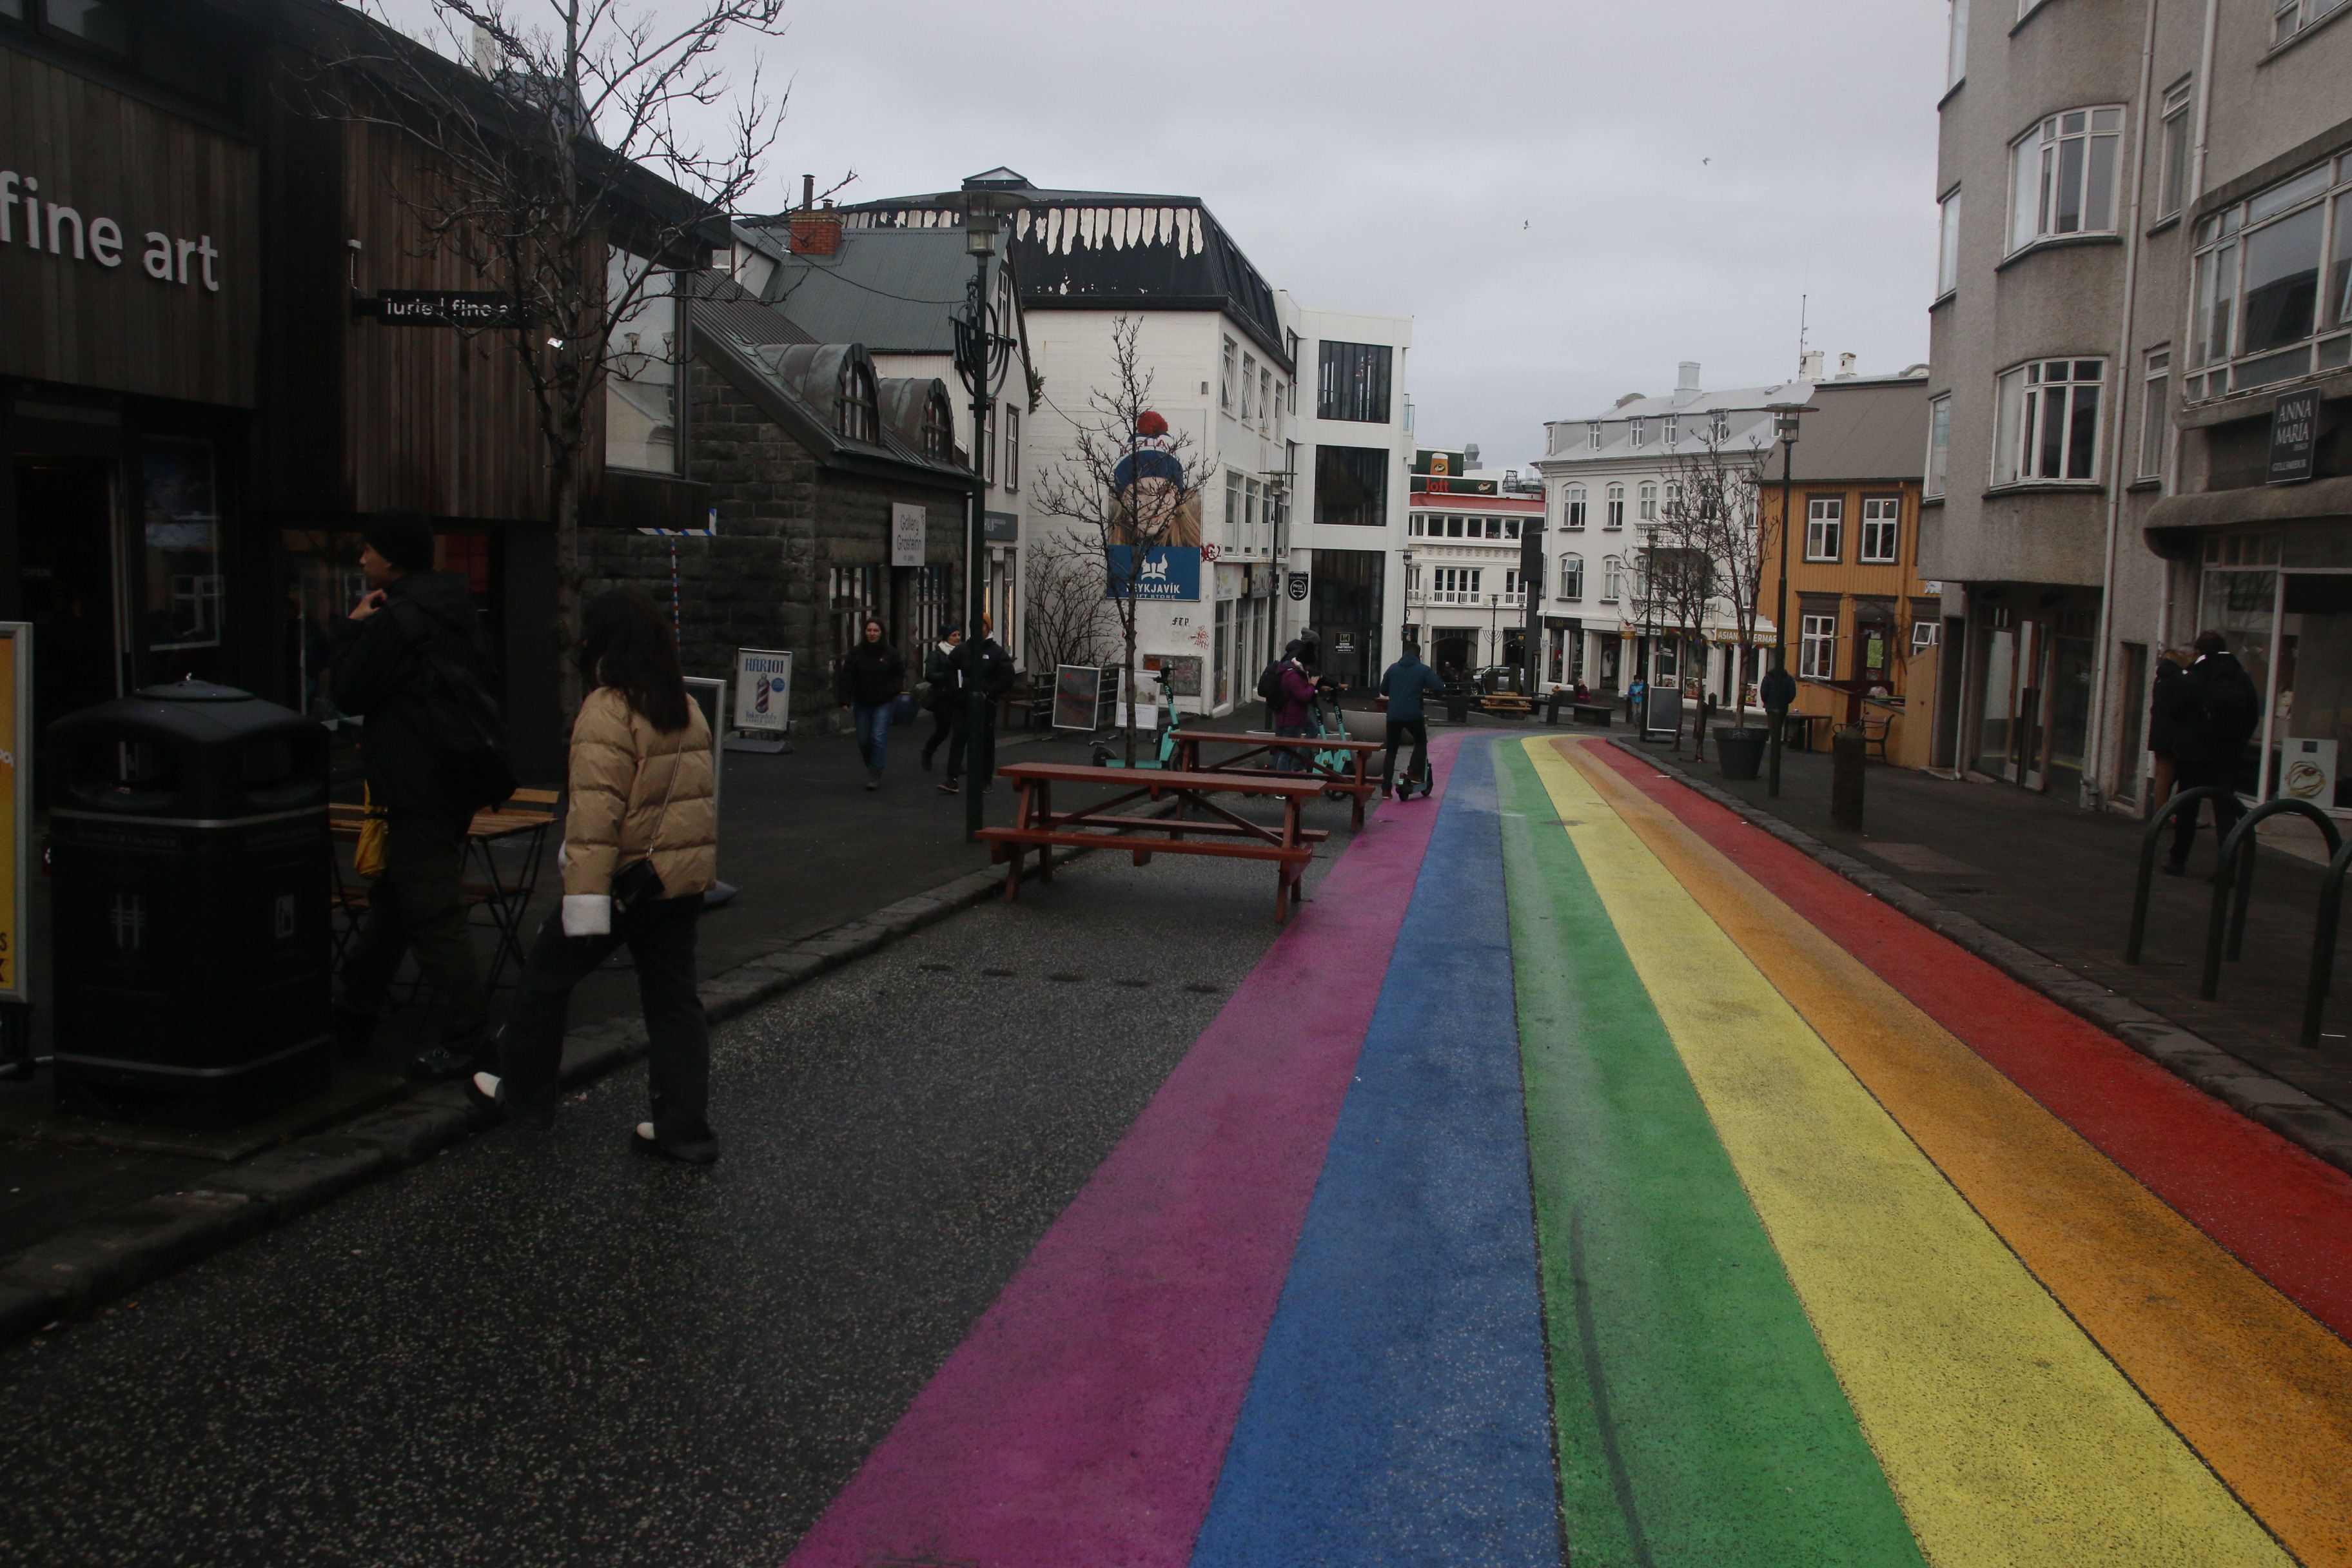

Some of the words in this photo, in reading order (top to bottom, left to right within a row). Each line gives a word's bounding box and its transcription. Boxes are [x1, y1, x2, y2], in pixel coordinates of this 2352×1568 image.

[0, 170, 123, 268] fine
[142, 231, 219, 291] art
[2278, 399, 2311, 422] ANNA
[2275, 419, 2308, 445] MARÍA
[1426, 478, 1449, 492] loft
[901, 514, 919, 536] Gallery
[22, 568, 52, 578] OPEN
[1718, 631, 1739, 640] ASIAN
